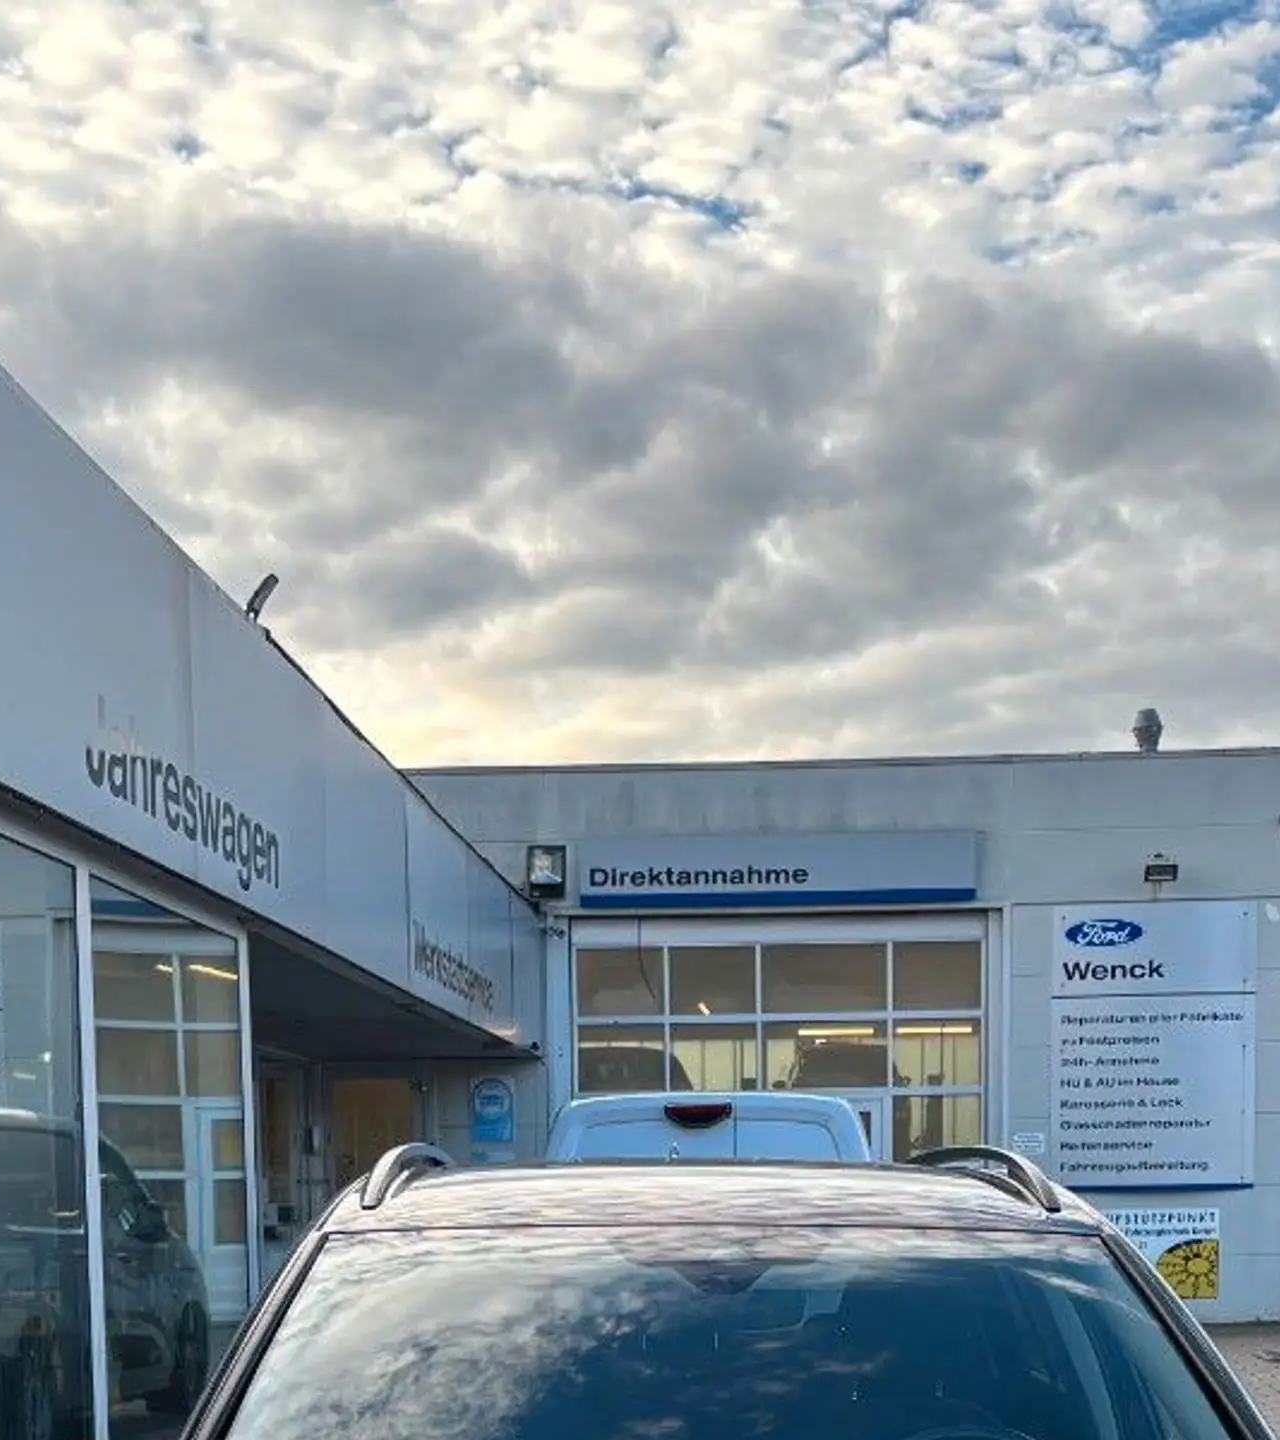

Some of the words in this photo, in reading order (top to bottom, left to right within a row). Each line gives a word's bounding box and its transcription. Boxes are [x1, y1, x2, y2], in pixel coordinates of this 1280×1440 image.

[588, 864, 809, 888] Direktannahme
[1074, 920, 1133, 946] Ford
[1062, 959, 1165, 981] Wenck
